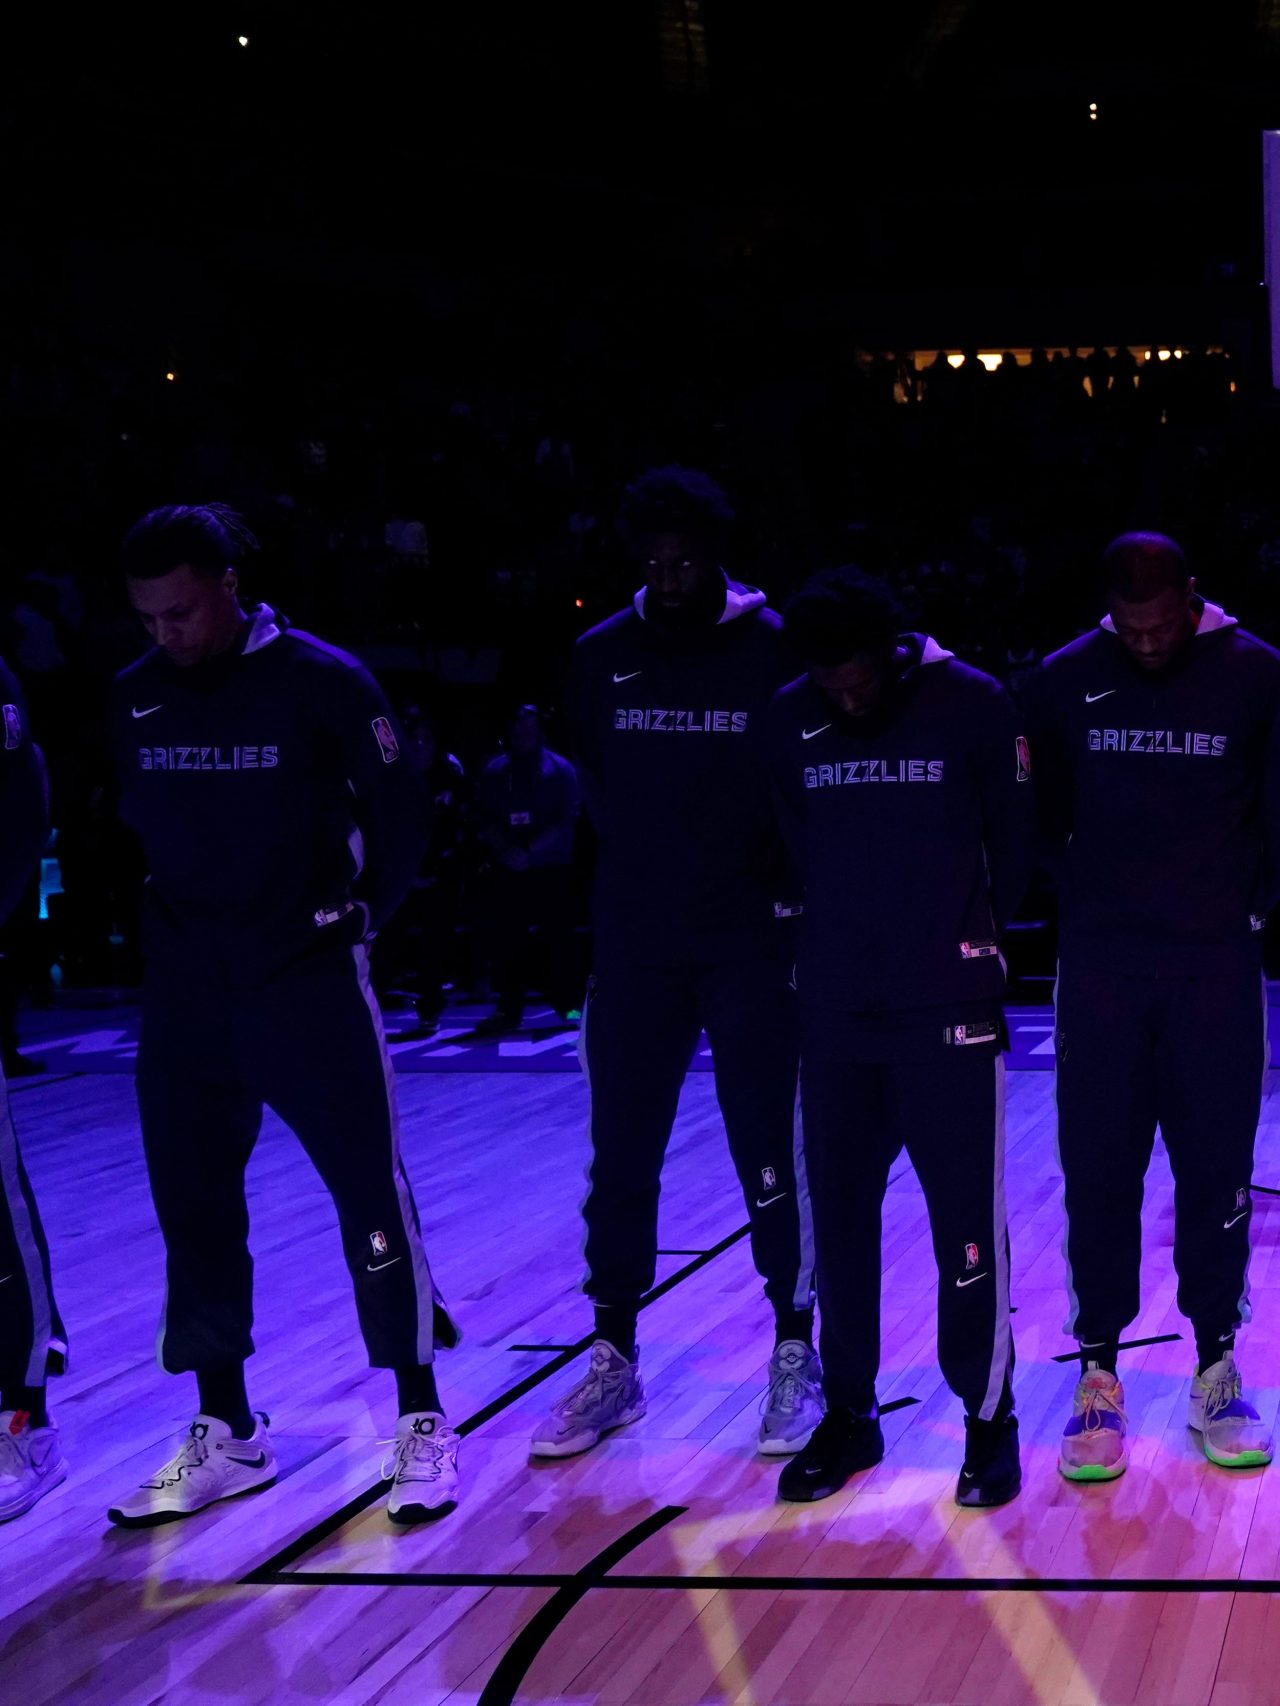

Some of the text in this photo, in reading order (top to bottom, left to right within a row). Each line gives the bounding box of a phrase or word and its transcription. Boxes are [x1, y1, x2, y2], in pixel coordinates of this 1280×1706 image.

[614, 708, 748, 733] GRIZZLIES
[1088, 728, 1227, 757] GRIZZLIES
[139, 745, 279, 771] GRIZZLIES
[804, 759, 944, 789] GRIZZLIES
